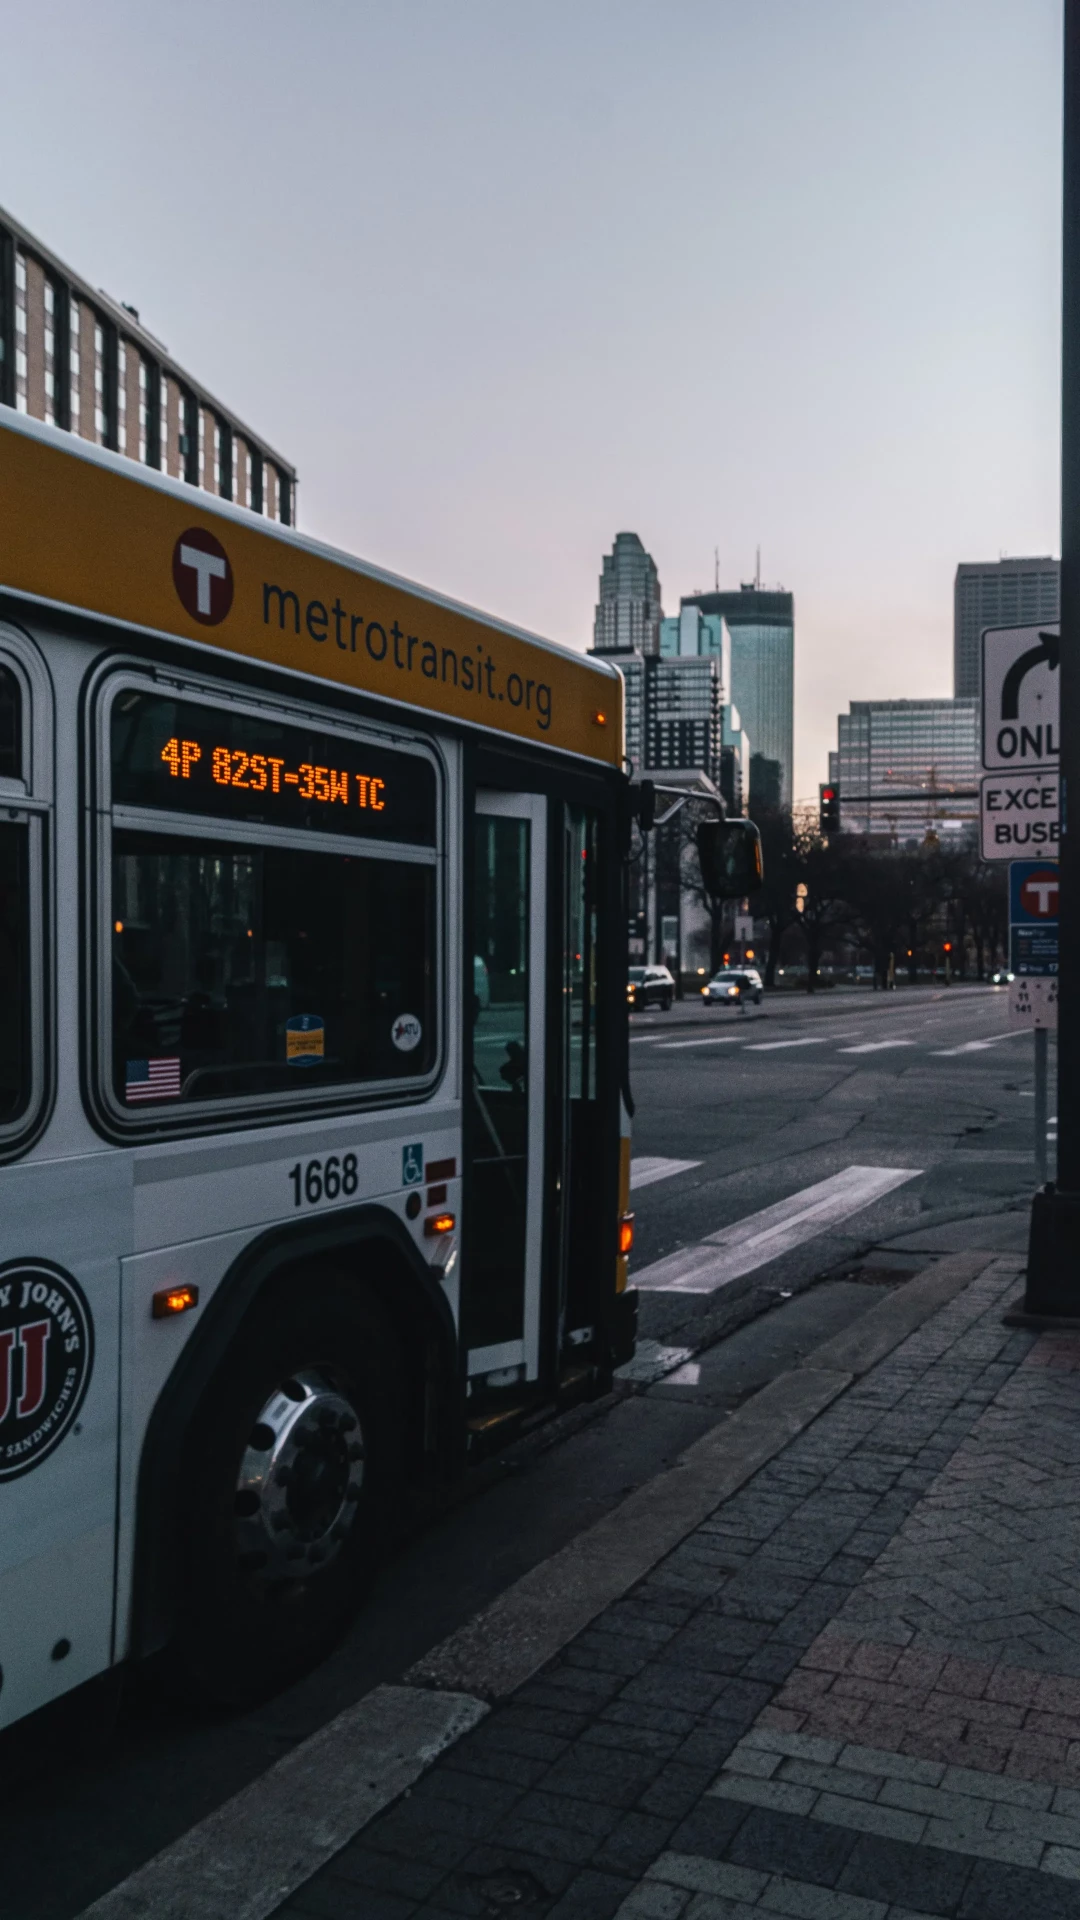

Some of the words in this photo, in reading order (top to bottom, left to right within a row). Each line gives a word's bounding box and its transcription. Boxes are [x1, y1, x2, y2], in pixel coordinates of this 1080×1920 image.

[263, 582, 552, 730] metrotransit.org
[997, 724, 1060, 759] ONL
[161, 738, 201, 778] 4P
[355, 774, 385, 810] TC
[986, 787, 1057, 811] EXCE
[995, 821, 1060, 845] BUSE
[404, 1023, 419, 1036] ATU
[288, 1153, 358, 1207] 1668
[19, 1280, 80, 1353] JOHN'S
[6, 1366, 77, 1458] SANDWICHES
